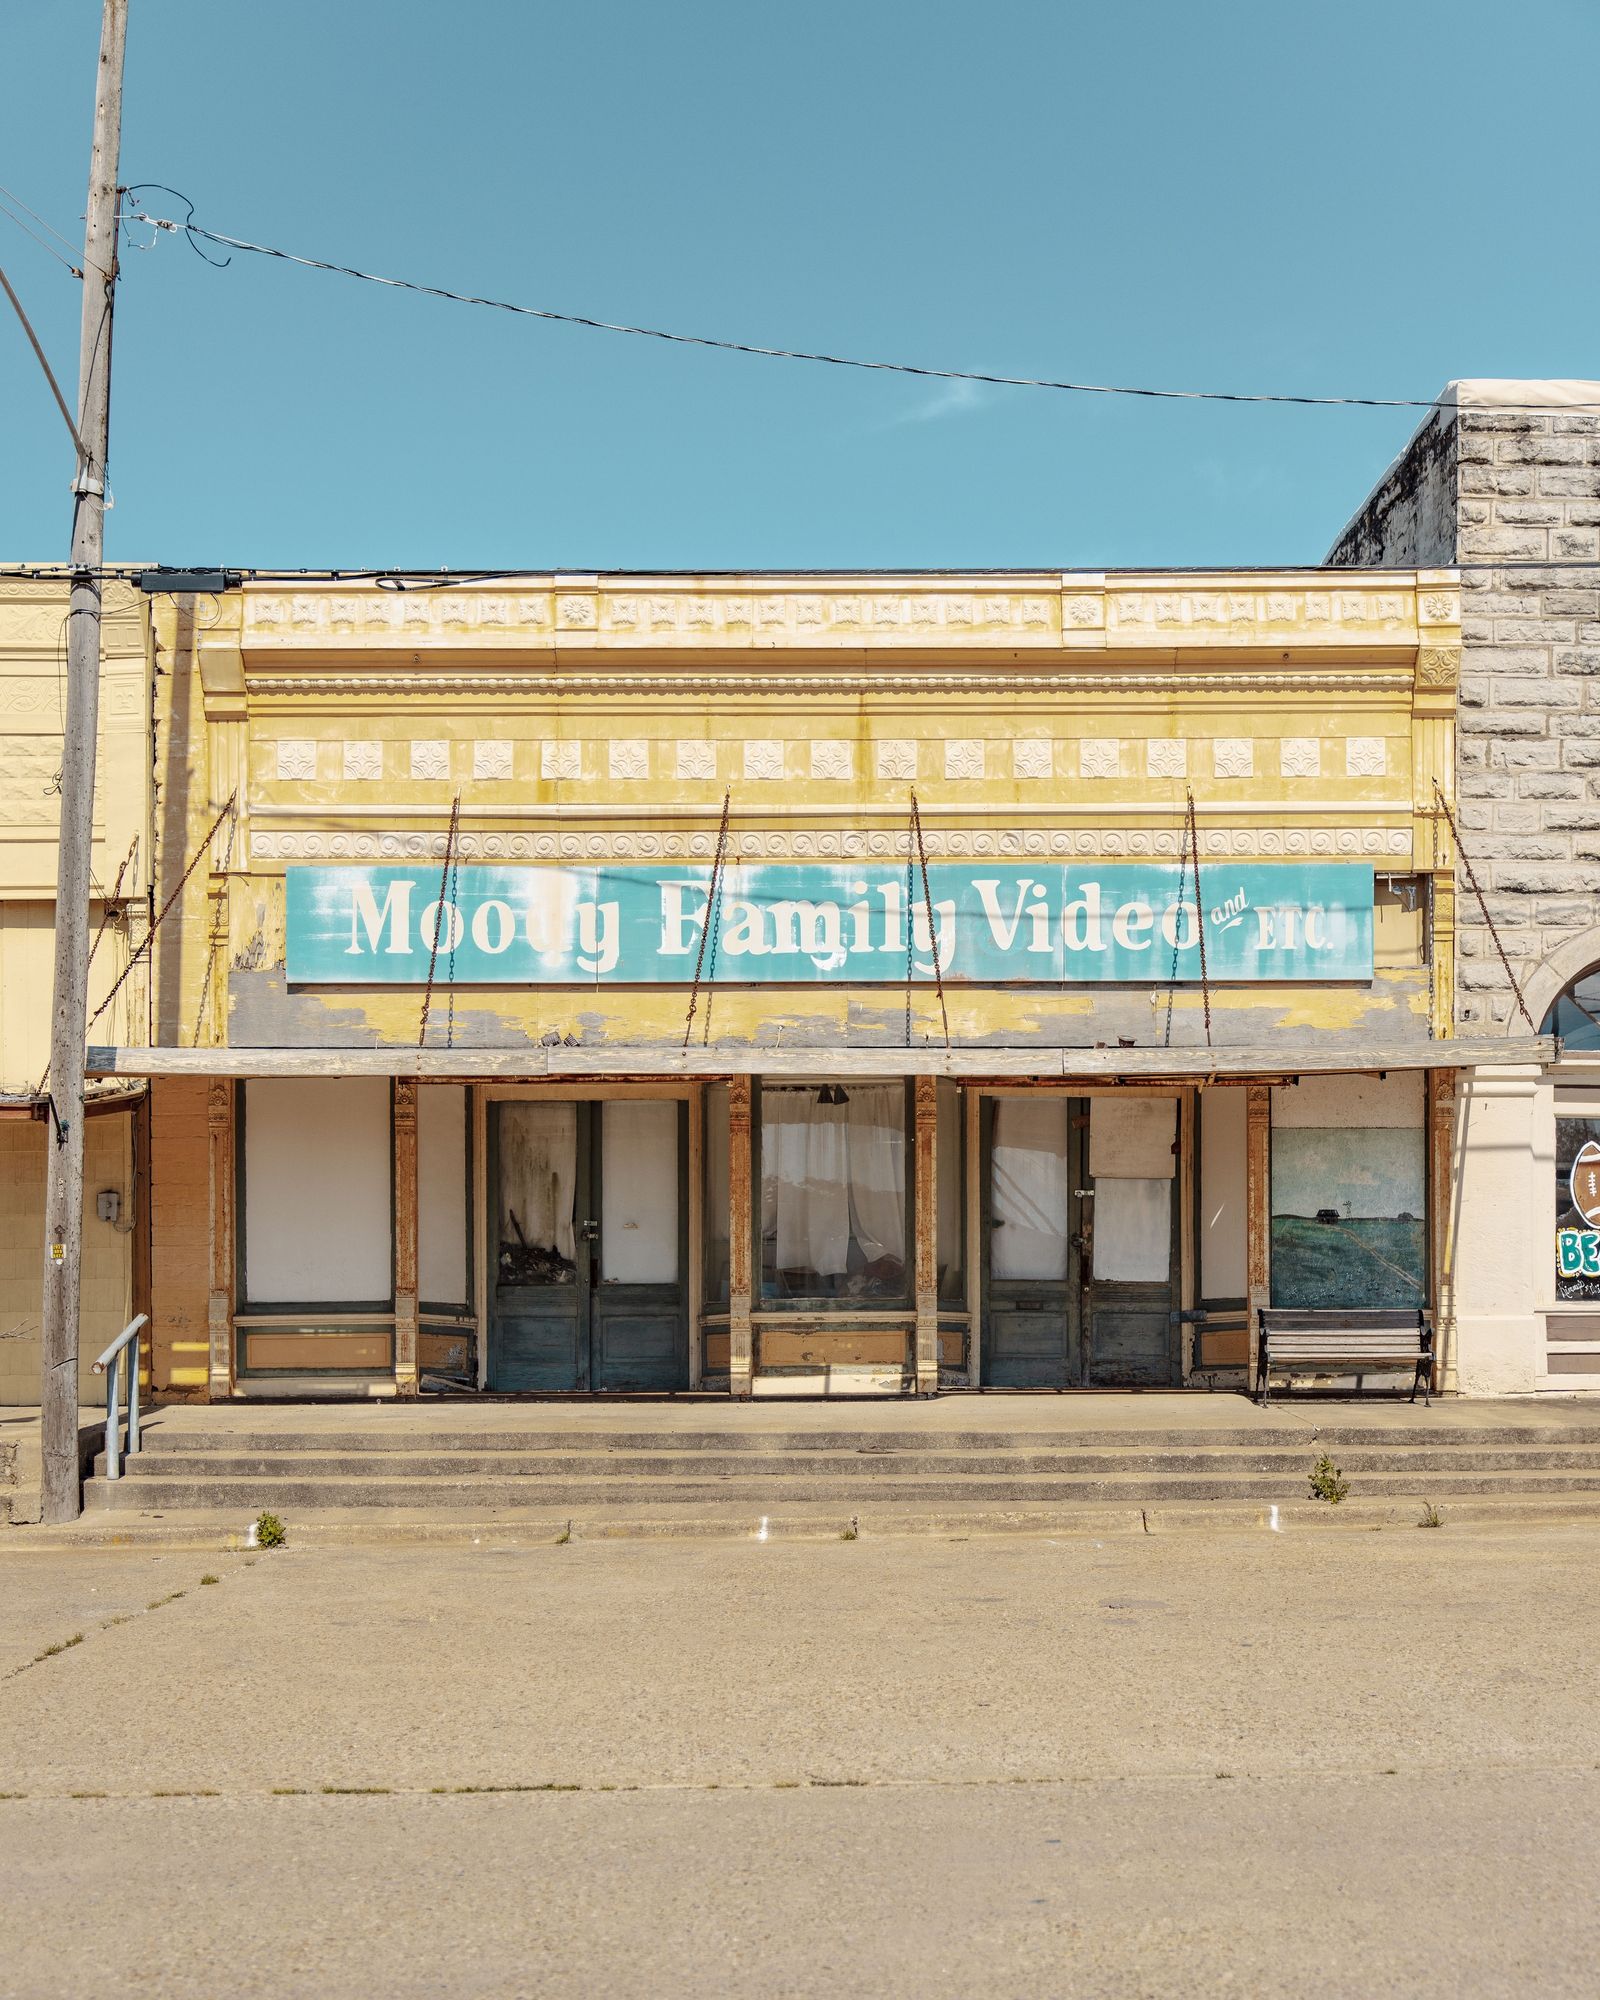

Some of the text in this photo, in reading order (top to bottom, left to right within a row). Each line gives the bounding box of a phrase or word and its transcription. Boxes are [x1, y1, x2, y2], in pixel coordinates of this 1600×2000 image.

[656, 880, 956, 975] Family
[970, 879, 1201, 953] Video
[1210, 886, 1251, 927] and
[1253, 905, 1335, 951] ETC.
[1559, 1230, 1600, 1275] BE
